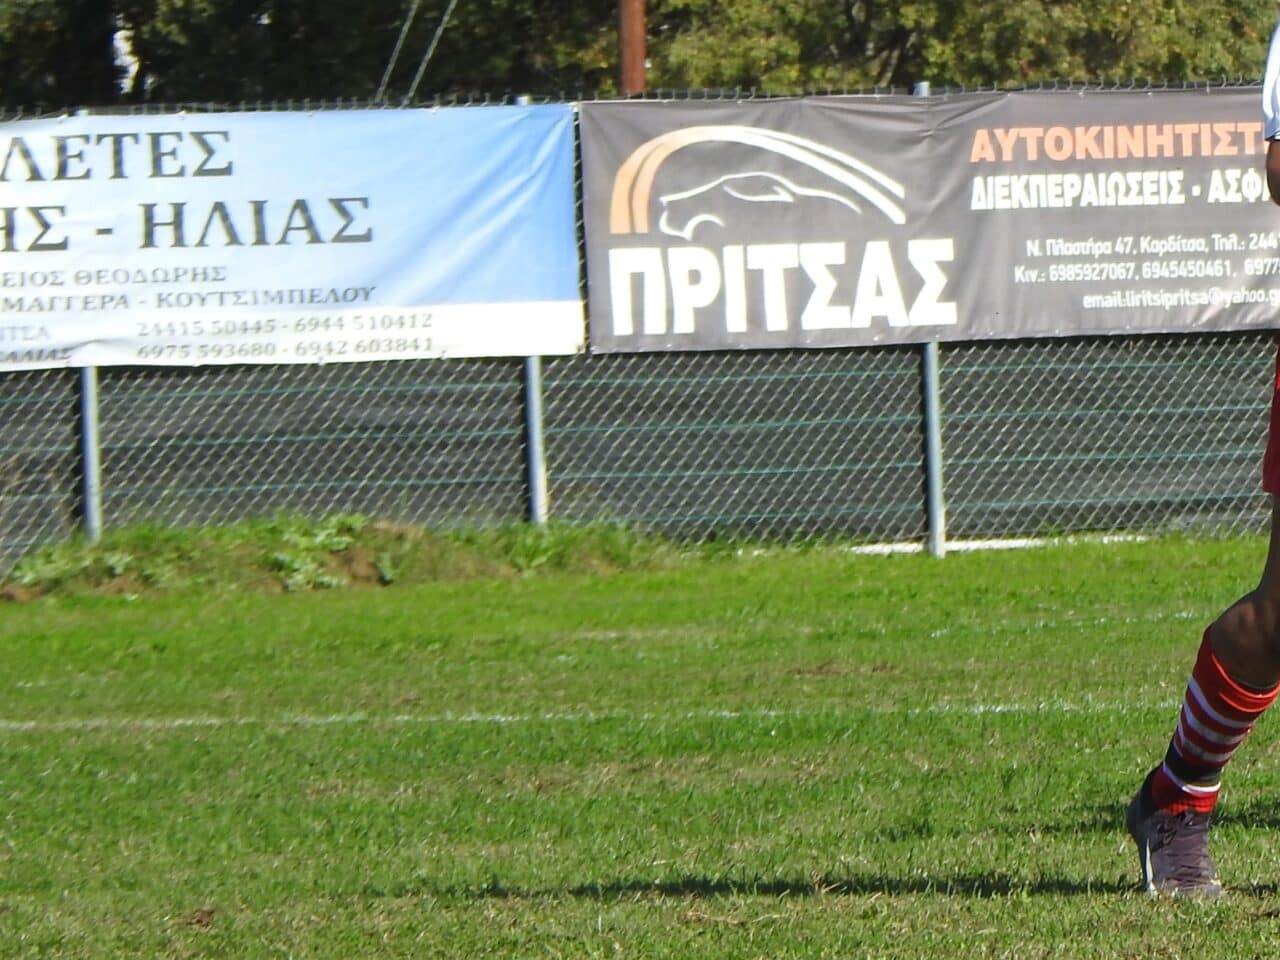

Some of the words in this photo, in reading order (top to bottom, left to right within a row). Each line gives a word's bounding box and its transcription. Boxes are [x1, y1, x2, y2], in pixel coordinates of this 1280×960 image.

[970, 121, 1266, 163] ΑΥΤΟΚΙΝΗΤΙΣΤ
[970, 169, 1185, 210] ΔΙΕΚΠΕΡΑΙΩΣΕΙΣ
[139, 196, 374, 249] ΗΛΙΑΣ
[73, 266, 227, 286] ΘΕΟΔΩΡΗΣ
[608, 238, 957, 336] ΠΡΙΤΣΑΣ
